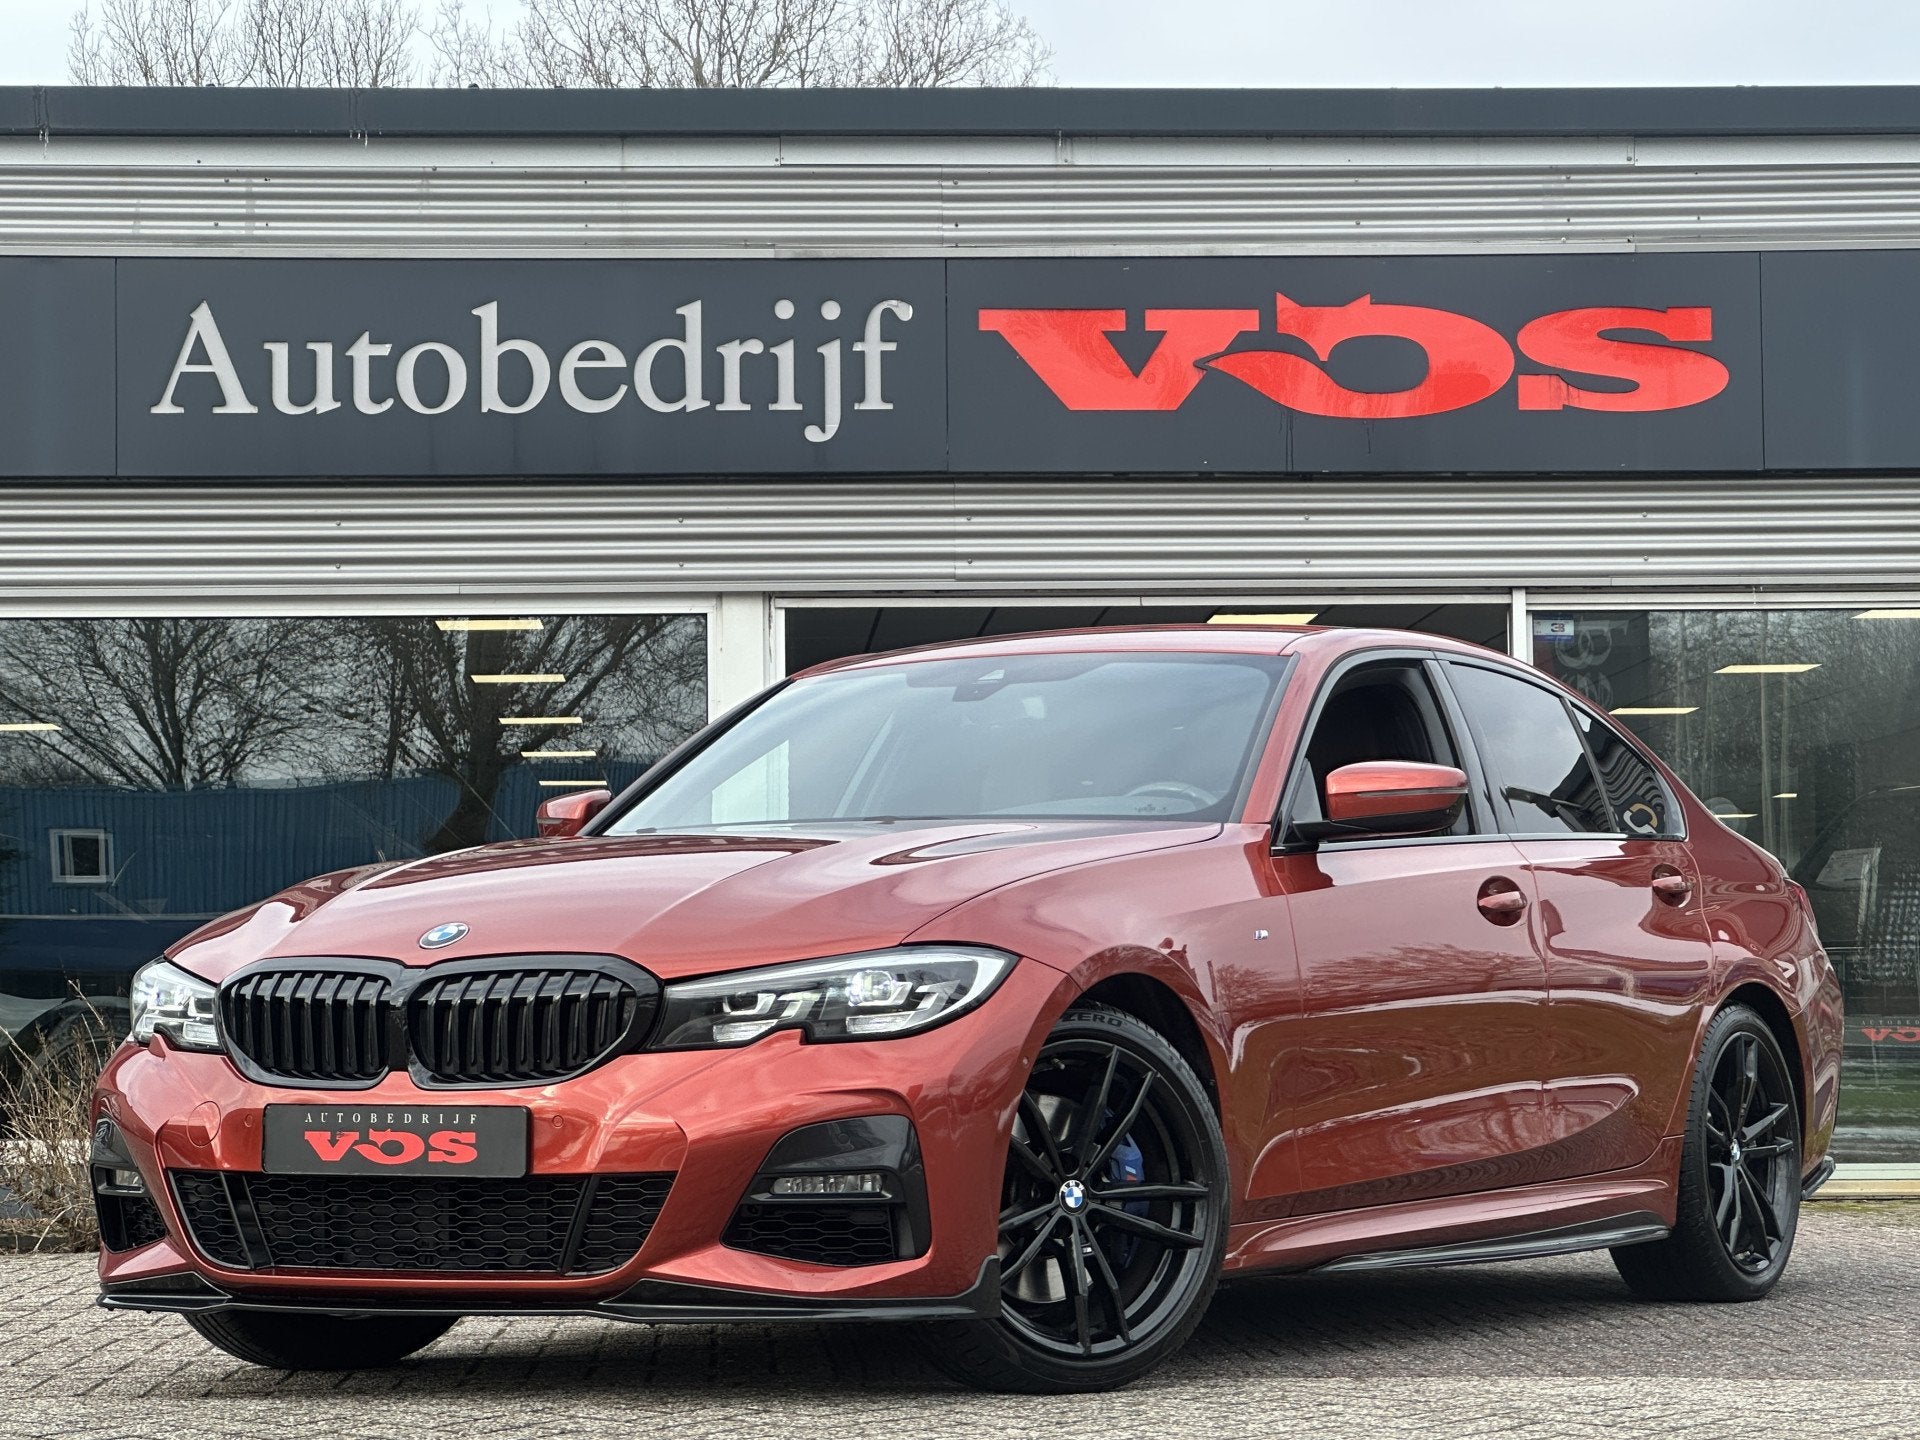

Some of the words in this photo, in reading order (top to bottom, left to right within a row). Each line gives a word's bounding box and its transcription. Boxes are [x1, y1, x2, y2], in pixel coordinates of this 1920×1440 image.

[150, 299, 915, 444] Autobedrijf
[979, 293, 1729, 419] VOS
[304, 1112, 477, 1124] AUTOBEDRIJF
[304, 1128, 478, 1165] VOS
